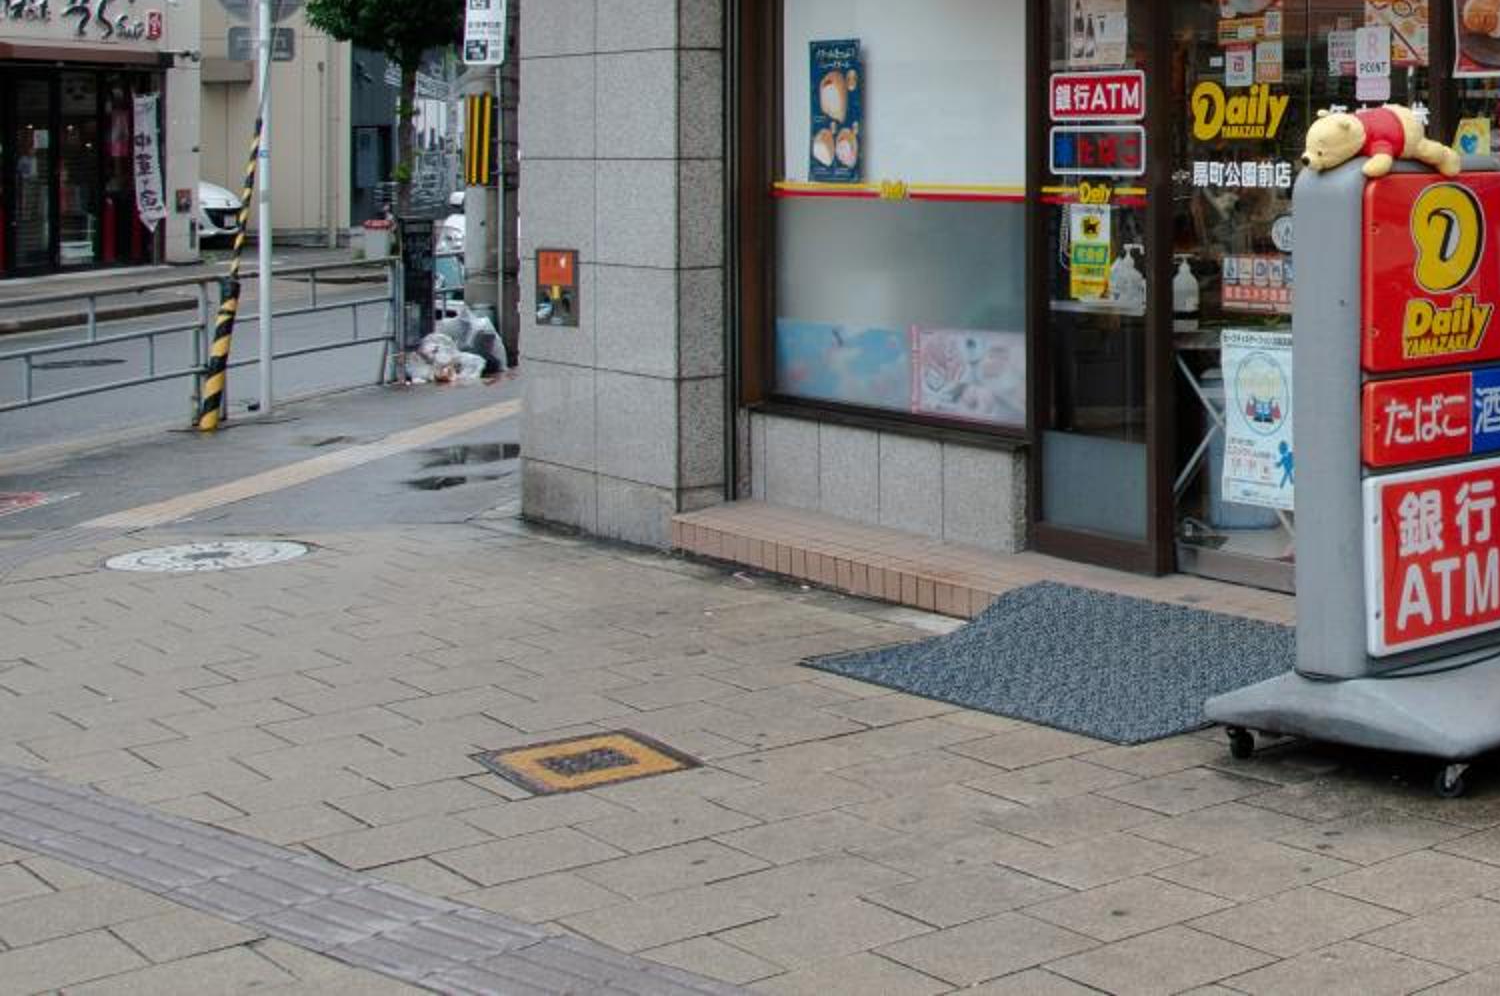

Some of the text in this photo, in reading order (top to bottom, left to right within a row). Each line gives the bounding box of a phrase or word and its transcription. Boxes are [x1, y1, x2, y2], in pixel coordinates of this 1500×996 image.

[1054, 80, 1140, 112] 銀行ATM
[1191, 81, 1289, 140] Daily
[1079, 181, 1112, 204] Daily
[1404, 294, 1493, 351] Daily
[1406, 332, 1468, 358] YAMAZAKI
[1383, 394, 1467, 446] たばこ
[1398, 479, 1497, 556] 銀行
[1396, 547, 1500, 631] ATM
